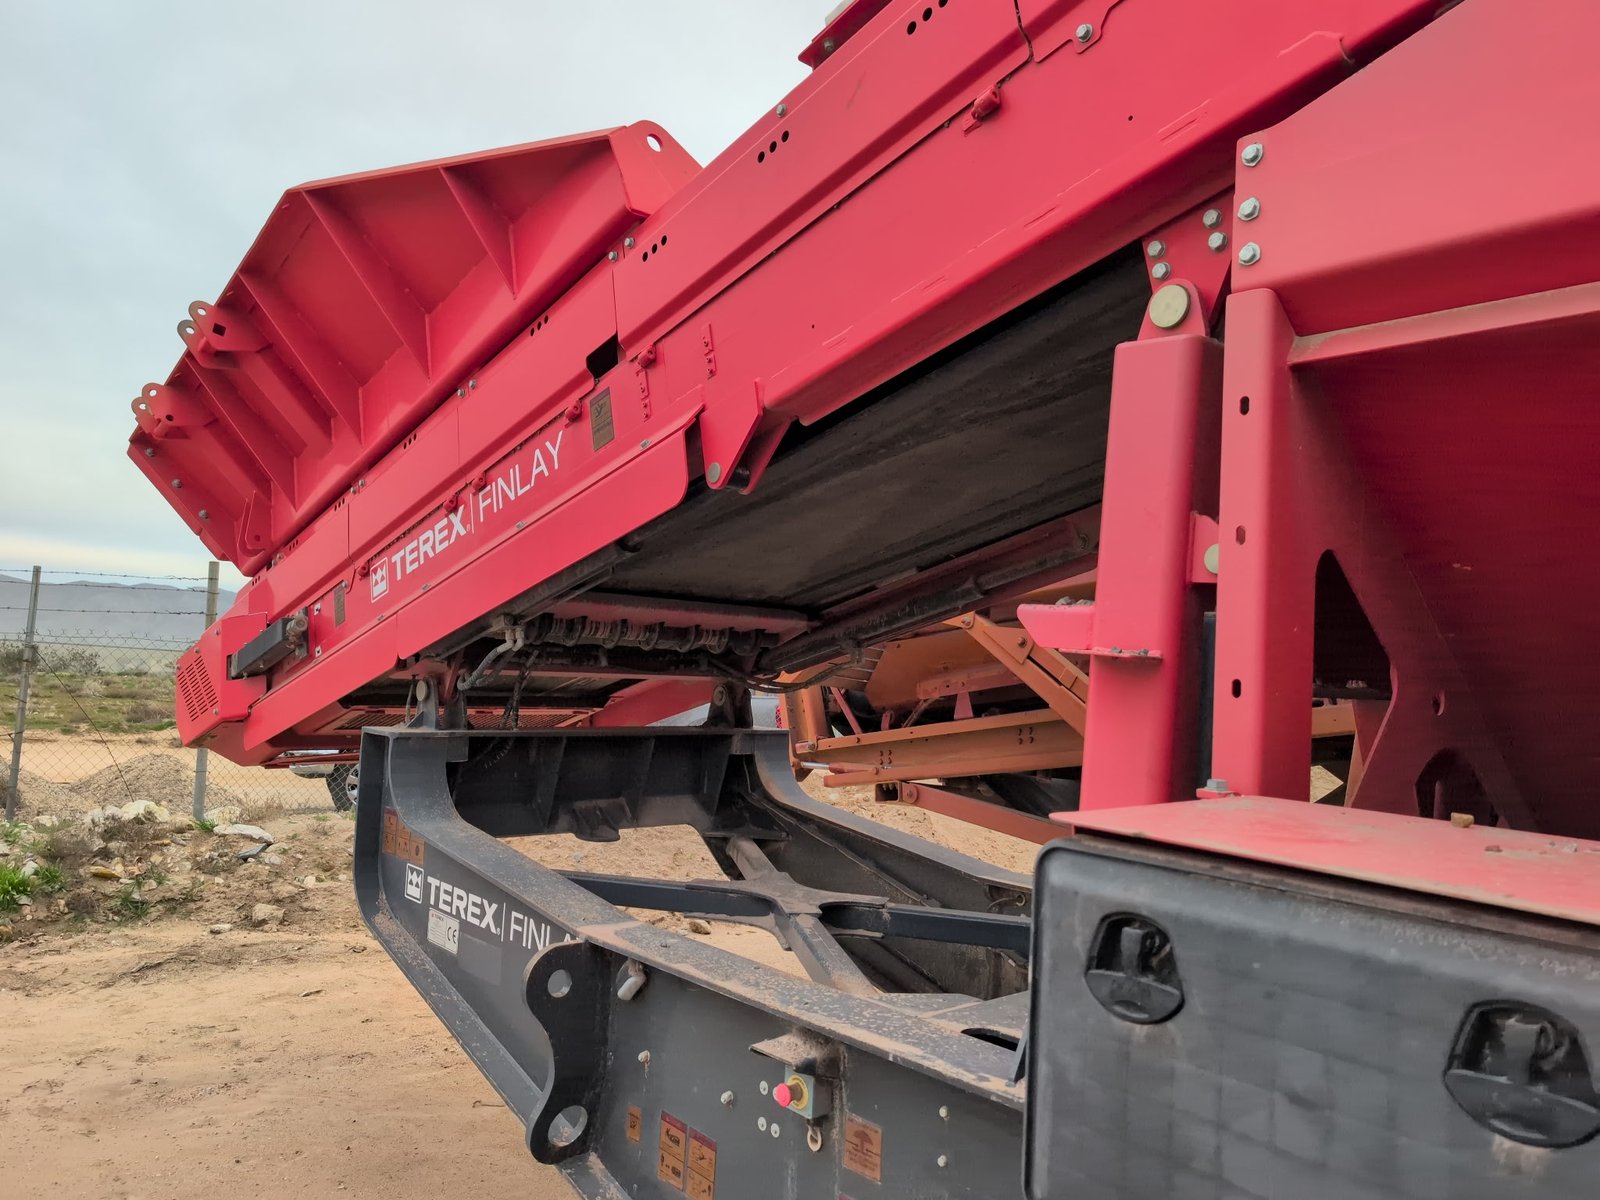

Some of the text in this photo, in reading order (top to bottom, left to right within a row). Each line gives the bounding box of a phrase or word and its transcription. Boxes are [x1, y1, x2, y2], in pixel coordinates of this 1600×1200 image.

[391, 430, 563, 581] TEREX FINLAY
[427, 876, 498, 935] TEREX
